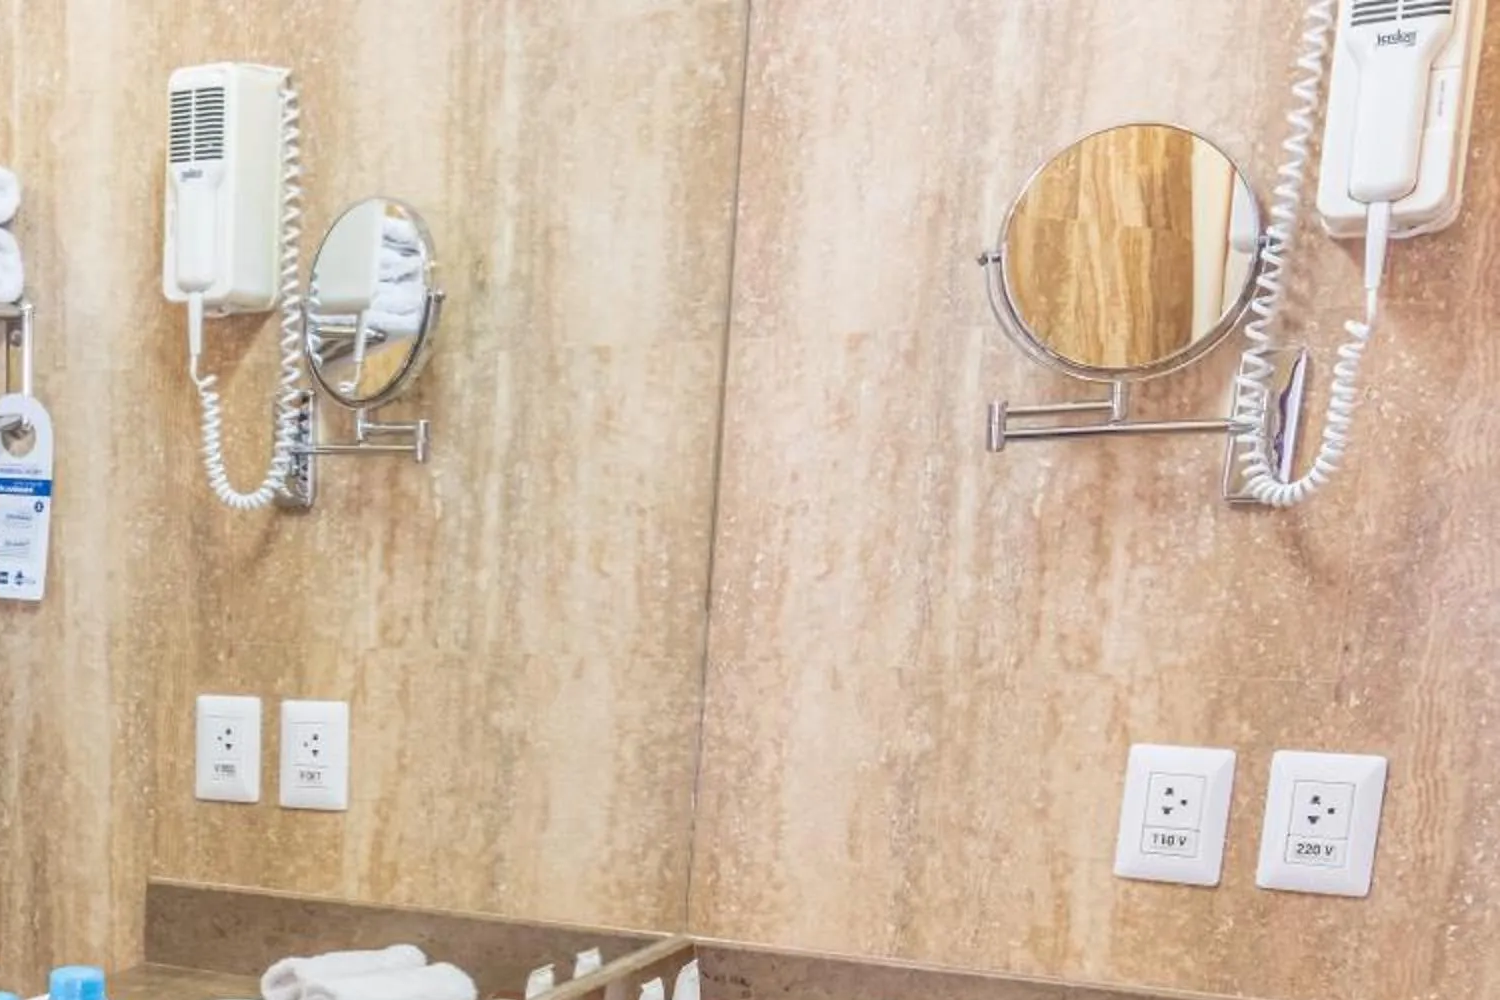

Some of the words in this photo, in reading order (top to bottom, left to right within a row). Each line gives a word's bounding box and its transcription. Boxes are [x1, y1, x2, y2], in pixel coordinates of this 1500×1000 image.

[1151, 832, 1175, 847] 110
[1178, 835, 1188, 847] V
[1296, 843, 1321, 856] 220
[1324, 845, 1335, 857] V
